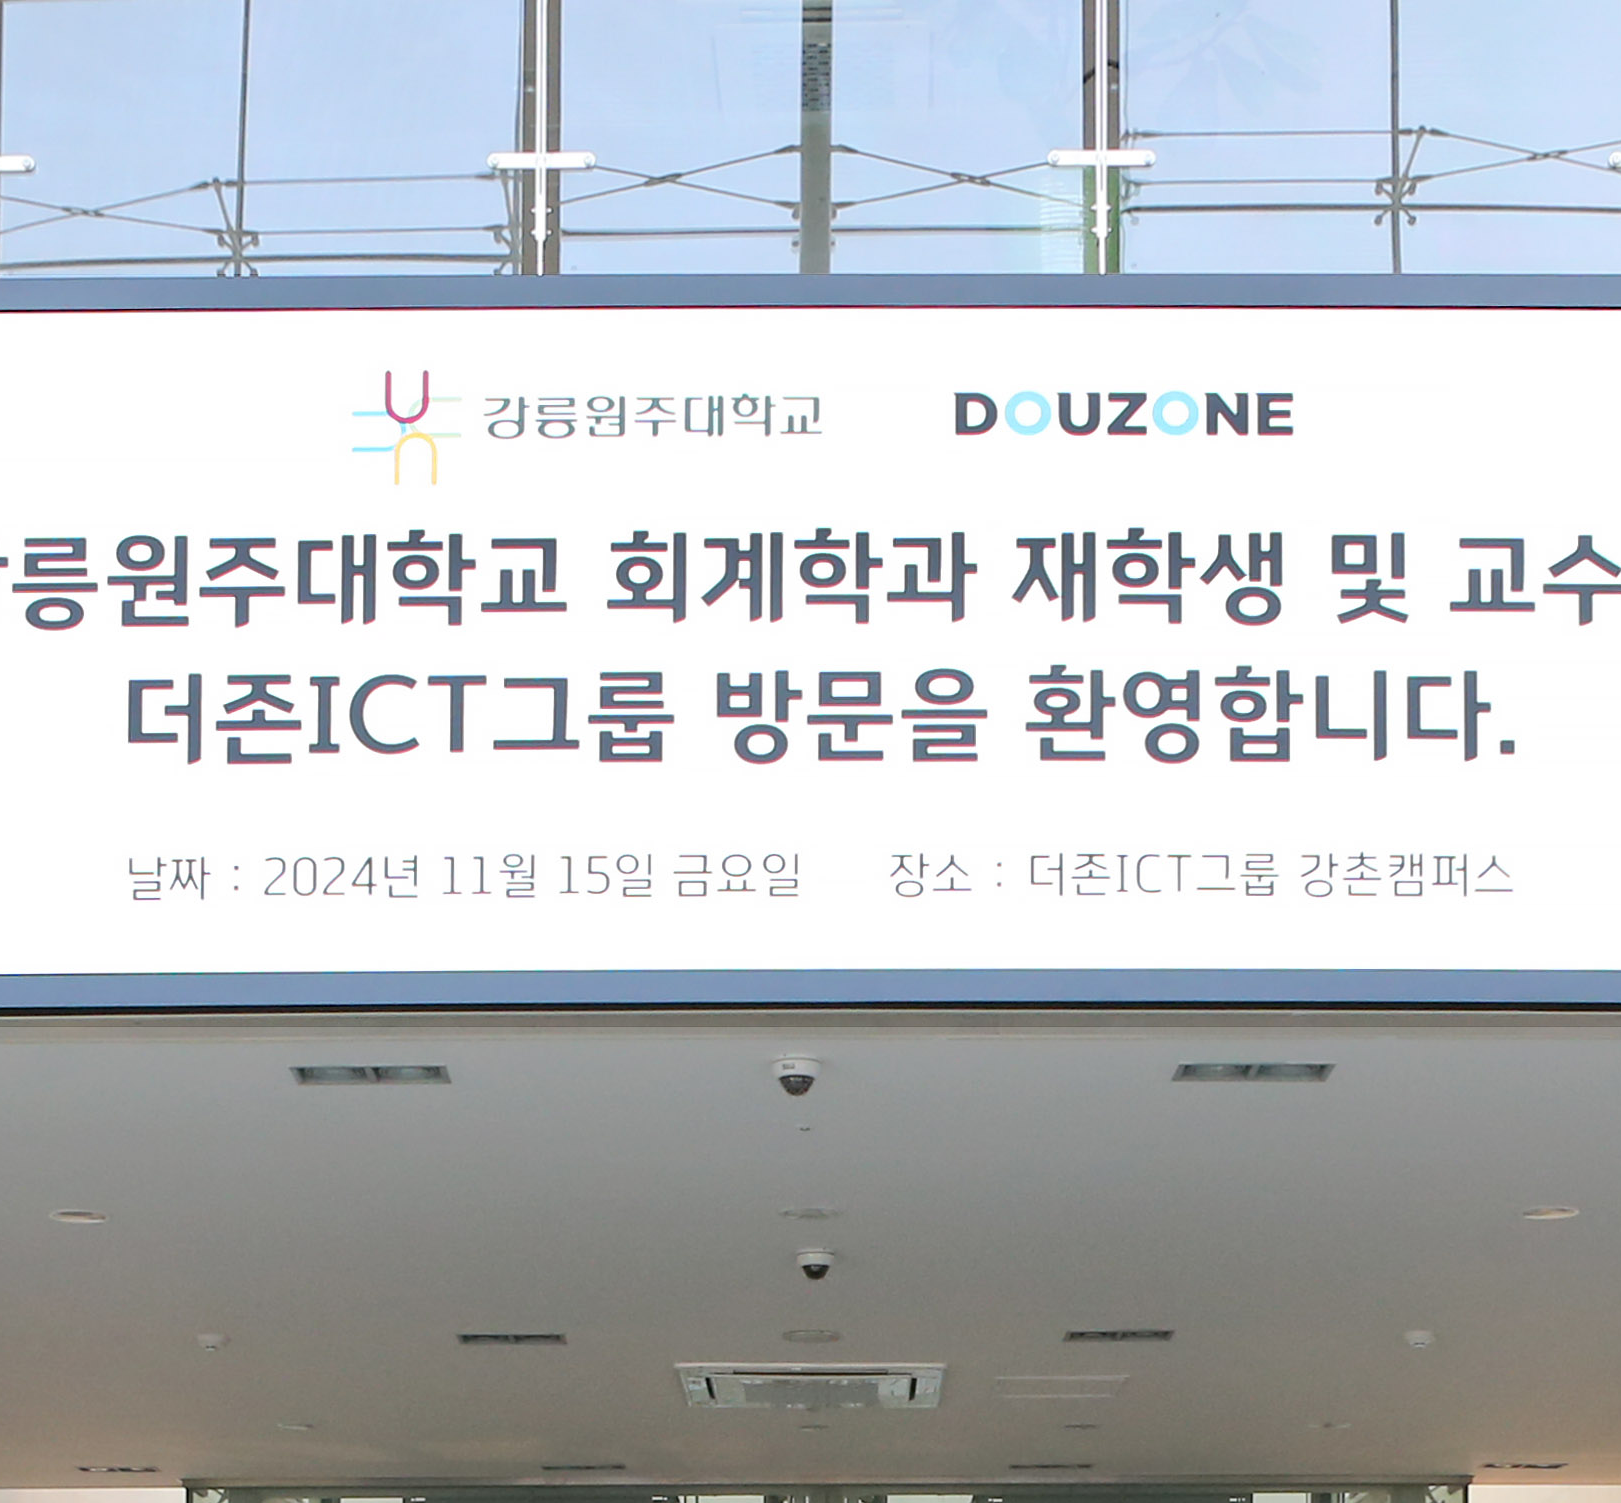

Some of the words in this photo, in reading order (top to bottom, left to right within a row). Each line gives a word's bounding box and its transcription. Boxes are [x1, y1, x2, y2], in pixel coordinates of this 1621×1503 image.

[484, 392, 822, 439] 강릉원주대학교
[953, 390, 1294, 436] DOUZONE
[607, 527, 977, 626] 회계학과
[1012, 527, 1284, 627] 재학생
[1331, 532, 1409, 625] 및
[128, 669, 675, 766] 더존ICT그룹
[717, 667, 988, 765] 방문을
[1025, 664, 1516, 765] 환영합니다.
[129, 855, 212, 901] 날짜
[264, 854, 419, 899] 2024년
[443, 853, 536, 899] 11월
[559, 853, 653, 898] 15일
[673, 852, 800, 898] 금요일
[890, 853, 973, 898] 장소
[1031, 852, 1280, 897] 더존ICT그룹
[1301, 851, 1514, 898] 강촌캠퍼스
